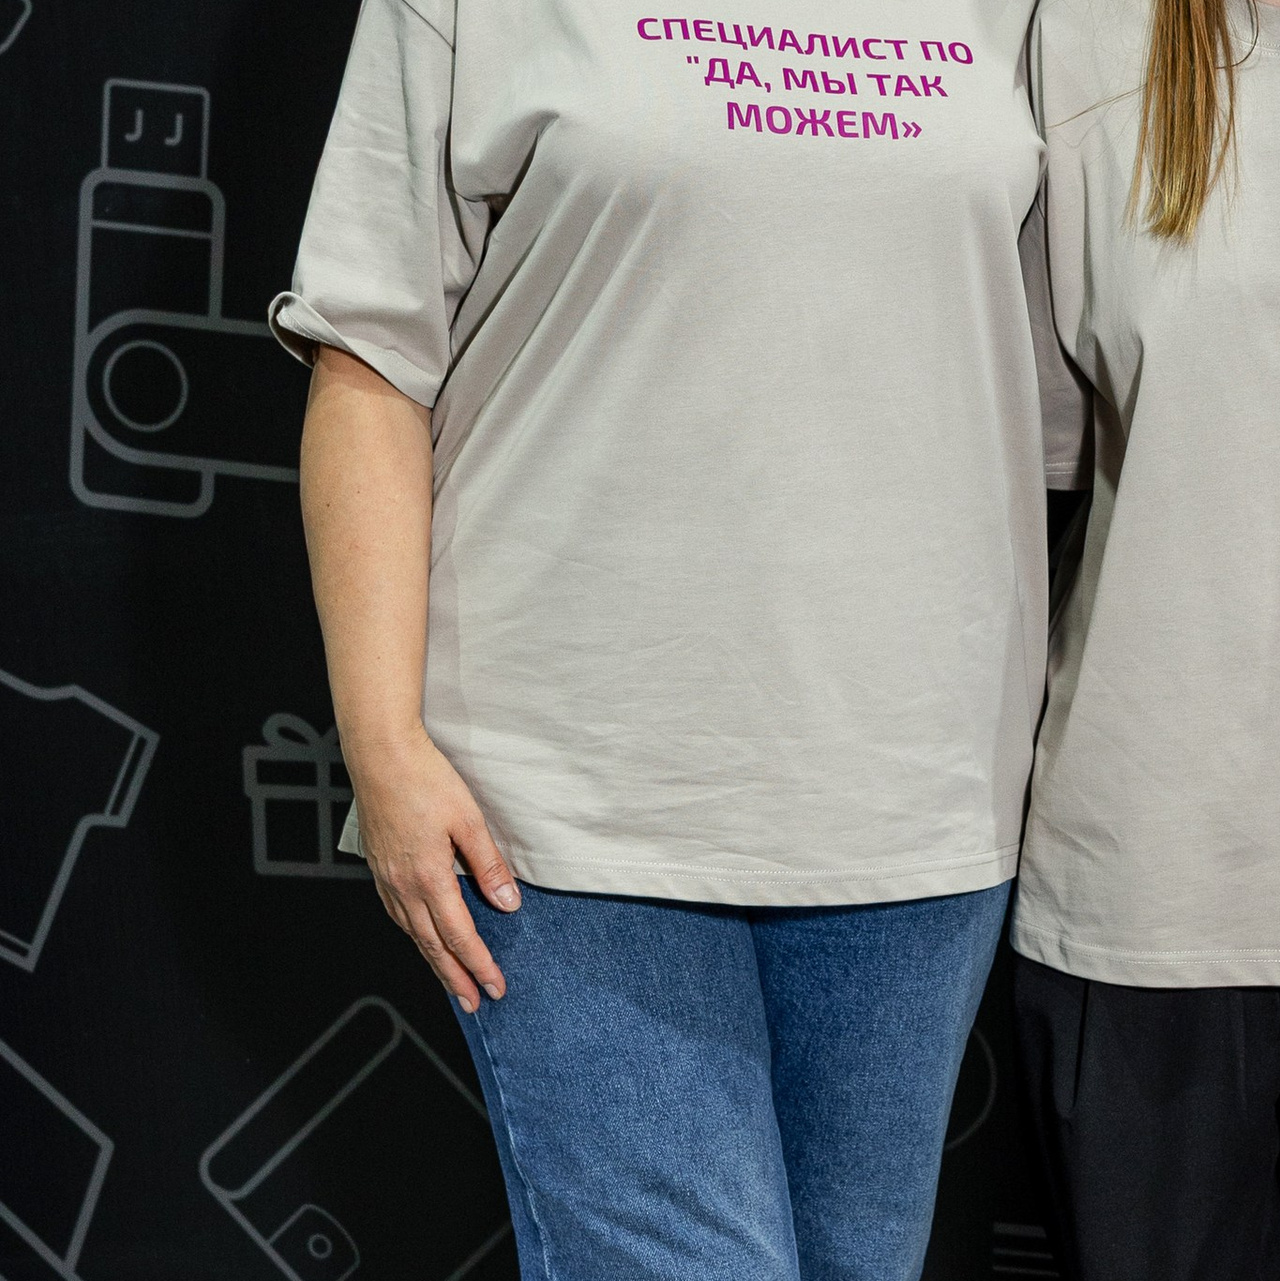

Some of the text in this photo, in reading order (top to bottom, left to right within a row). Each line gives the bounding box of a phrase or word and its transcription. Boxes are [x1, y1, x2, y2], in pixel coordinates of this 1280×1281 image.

[636, 17, 975, 65] СПЕЦИАЛИСТ ПО
[686, 55, 949, 98] "ДА, МЫ ТАК
[726, 101, 923, 141] МОЖЕМ»
